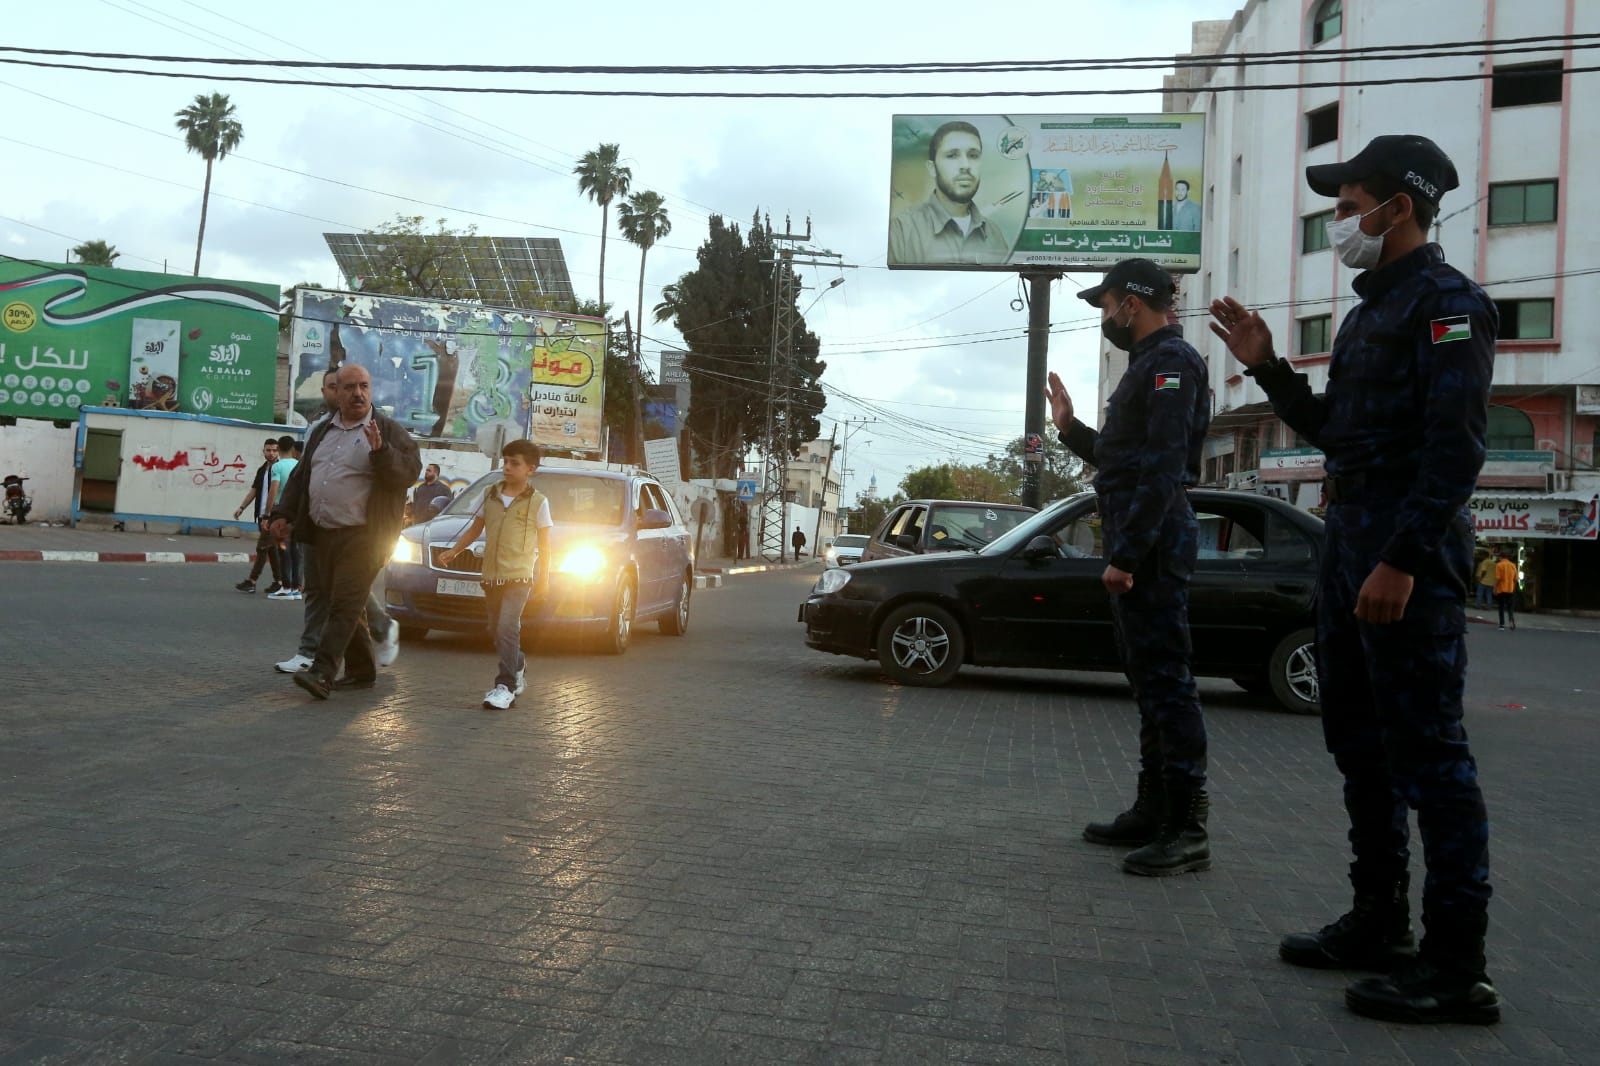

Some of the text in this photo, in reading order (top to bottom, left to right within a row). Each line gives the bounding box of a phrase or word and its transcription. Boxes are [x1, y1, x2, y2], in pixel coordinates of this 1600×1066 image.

[1405, 170, 1438, 198] POLICE
[1042, 233, 1172, 250] نضال فتحي فرحات
[1126, 282, 1155, 296] POLICE
[8, 309, 30, 319] 30%
[230, 332, 252, 341] قهوة
[15, 345, 89, 371] للكل
[217, 367, 251, 376] BALAD
[532, 390, 588, 404] عائلة مناديل
[543, 405, 577, 417] اختيارك
[1468, 500, 1529, 513] ميني مارك
